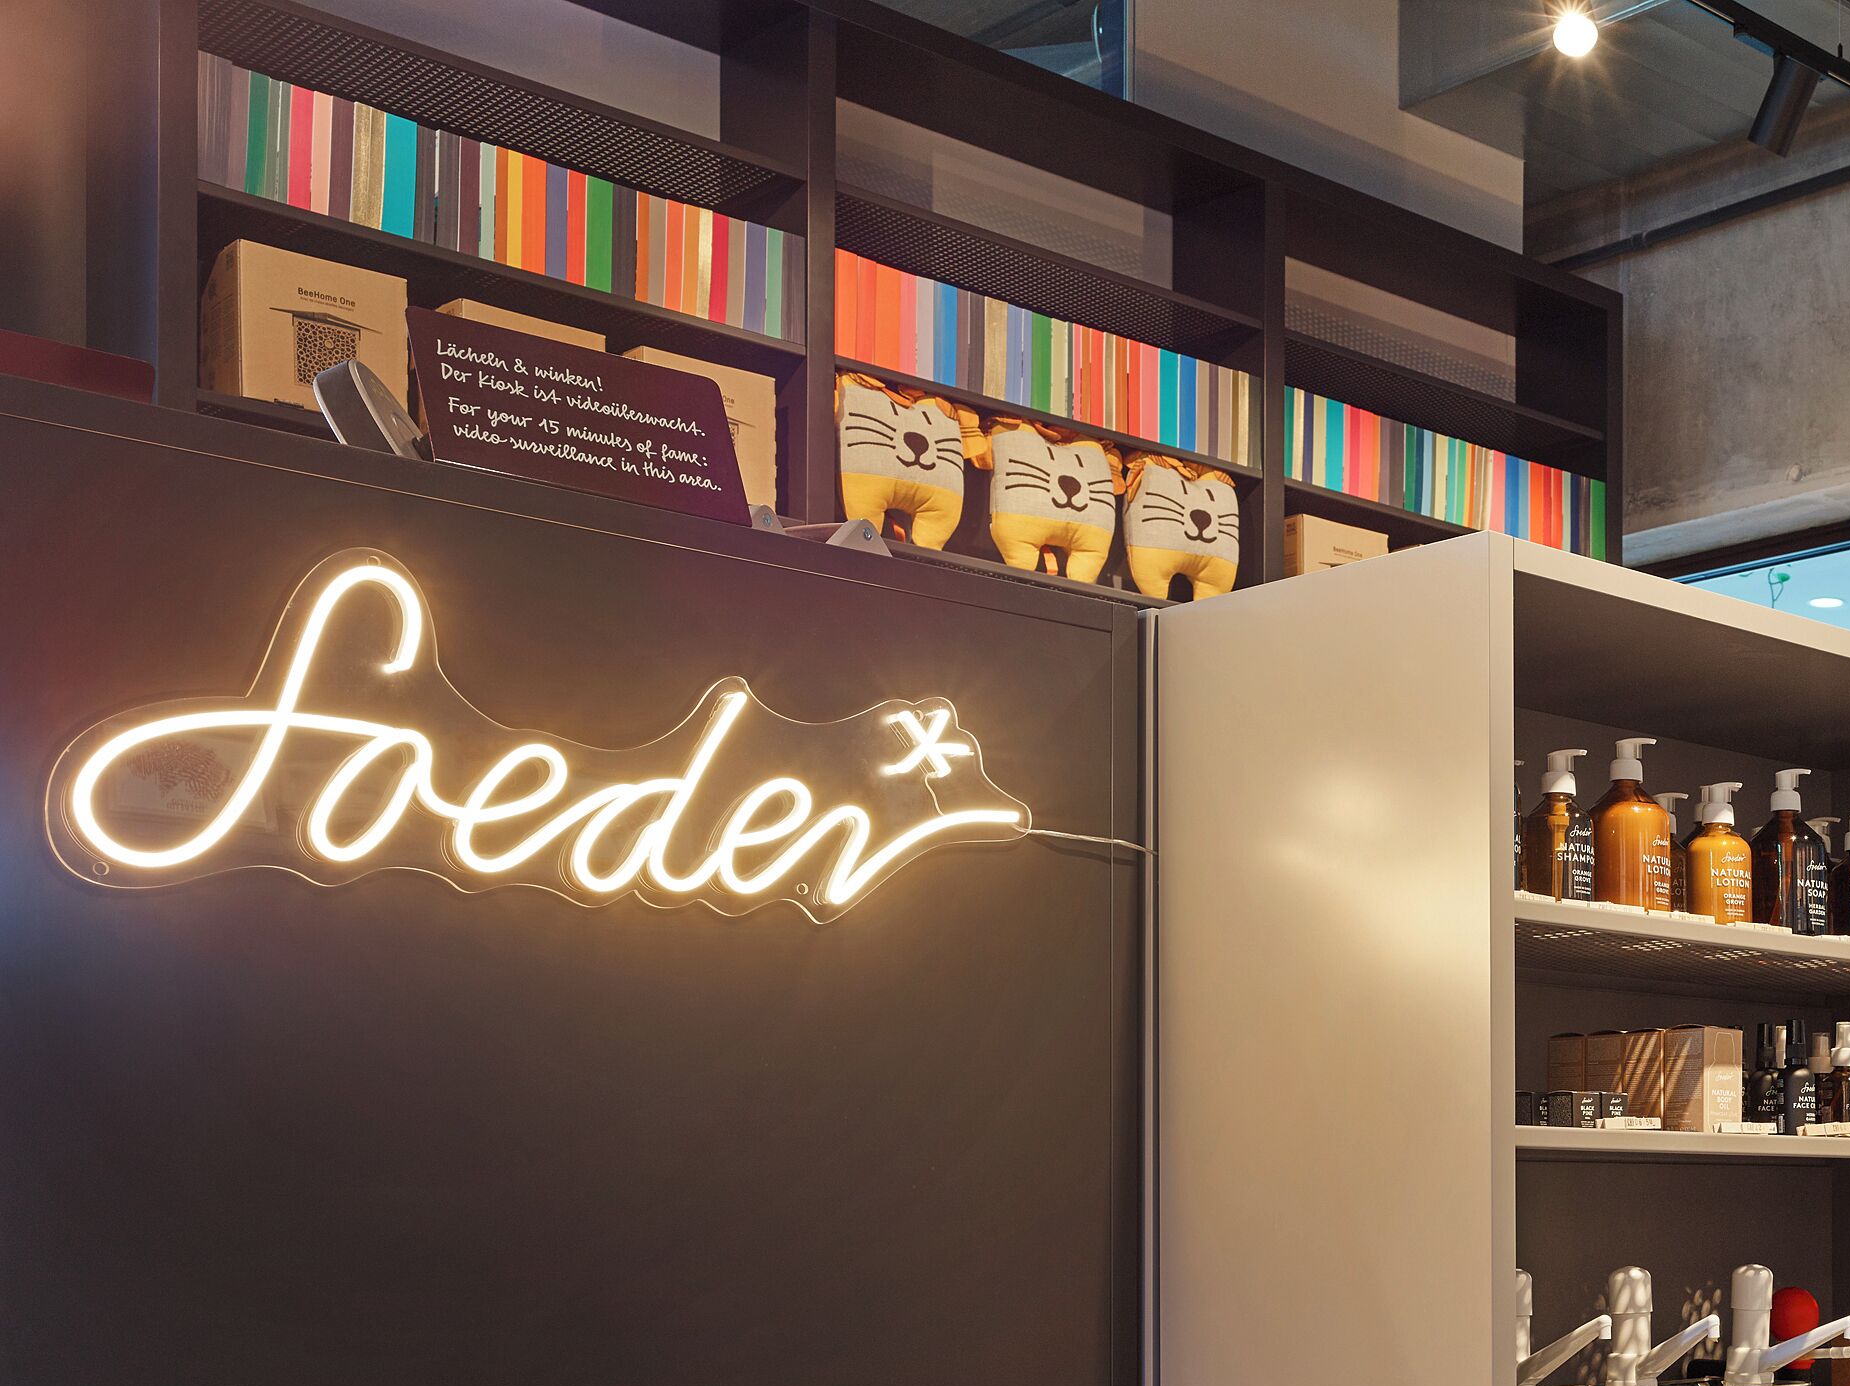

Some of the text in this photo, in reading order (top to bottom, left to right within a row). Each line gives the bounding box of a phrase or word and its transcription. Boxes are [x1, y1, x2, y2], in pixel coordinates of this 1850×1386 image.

[298, 287, 337, 304] BeeHome
[340, 297, 356, 307] One
[436, 339, 604, 391] Lächeln & winken!
[441, 362, 706, 437] Der Kiosk ist videoüberwacht.
[448, 397, 708, 466] For your 15 minutes of fame:
[453, 424, 722, 492] video surveillance in this area.
[1716, 878, 1750, 889] LOTION
[1726, 898, 1745, 906] GROVE
